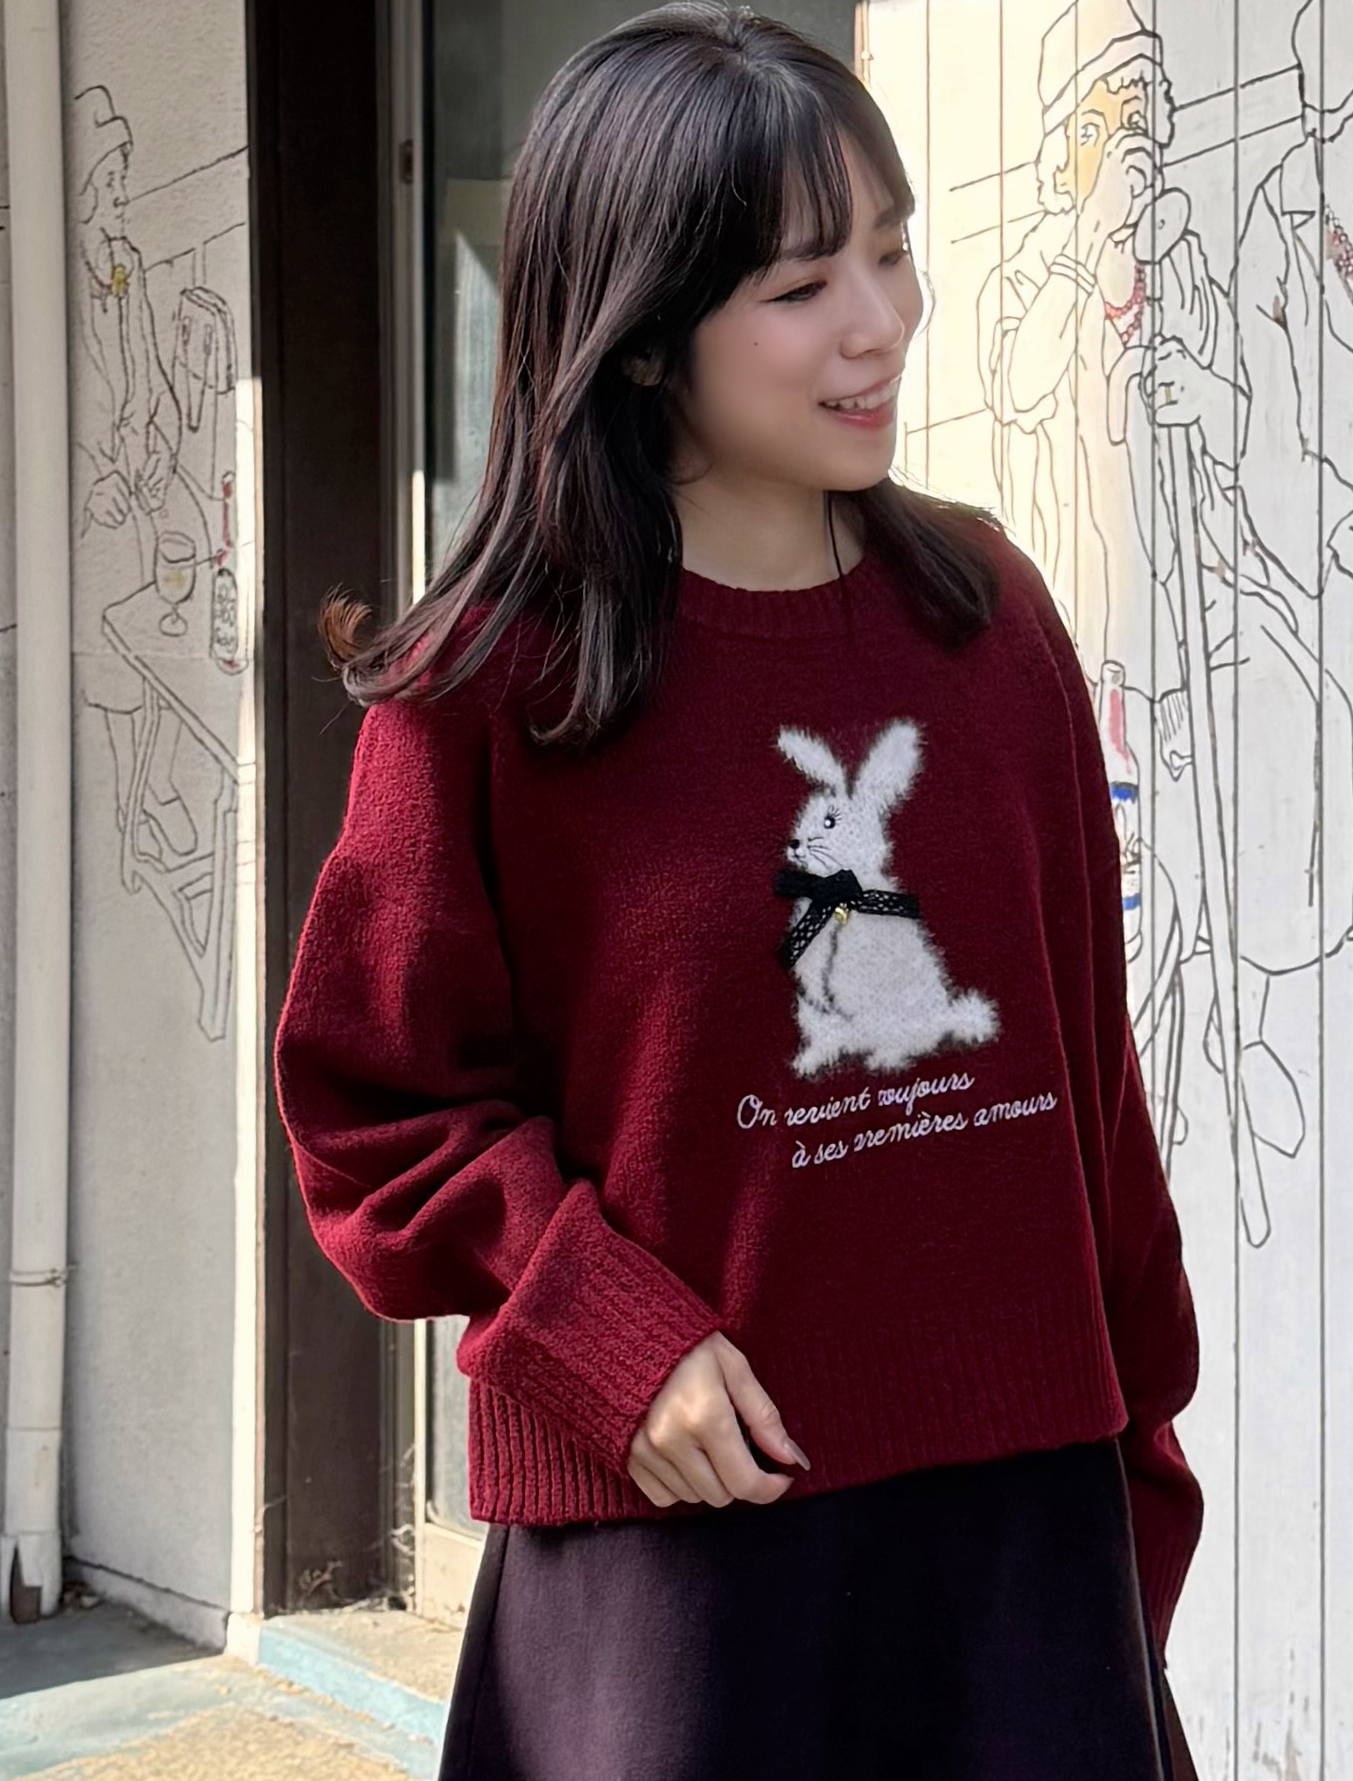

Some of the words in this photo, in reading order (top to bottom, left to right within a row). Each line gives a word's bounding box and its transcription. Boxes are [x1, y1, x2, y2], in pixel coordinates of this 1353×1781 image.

[736, 1093, 777, 1129] On
[791, 1139, 812, 1168] à
[813, 1139, 849, 1165] ses
[973, 1091, 1059, 1127] amours
